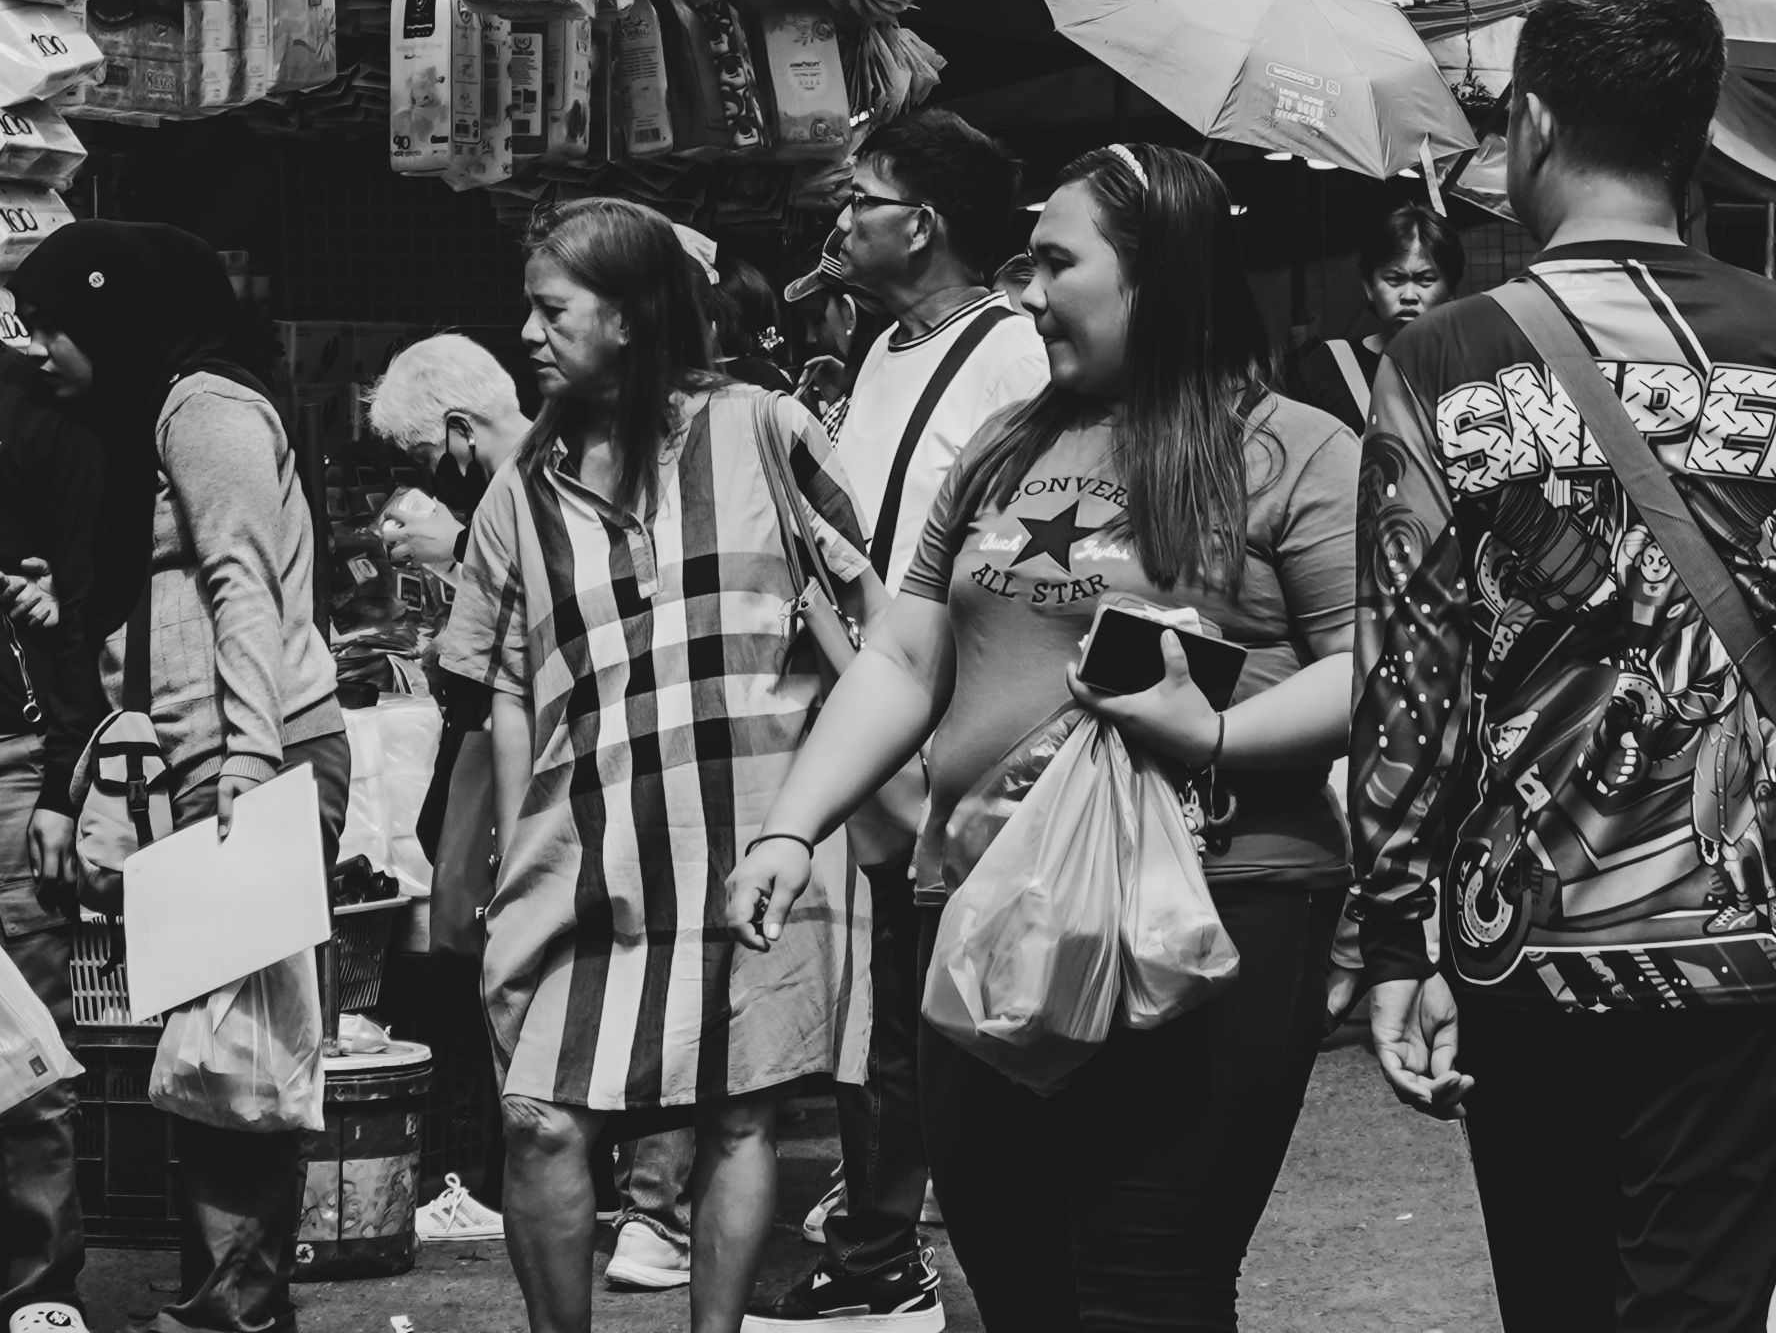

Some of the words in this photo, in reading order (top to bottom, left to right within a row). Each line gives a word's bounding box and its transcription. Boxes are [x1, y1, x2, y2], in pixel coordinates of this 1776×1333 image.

[30, 31, 69, 58] 100
[1074, 539, 1131, 562] Taylor
[971, 562, 1017, 599] ALL
[1031, 573, 1110, 605] STAR
